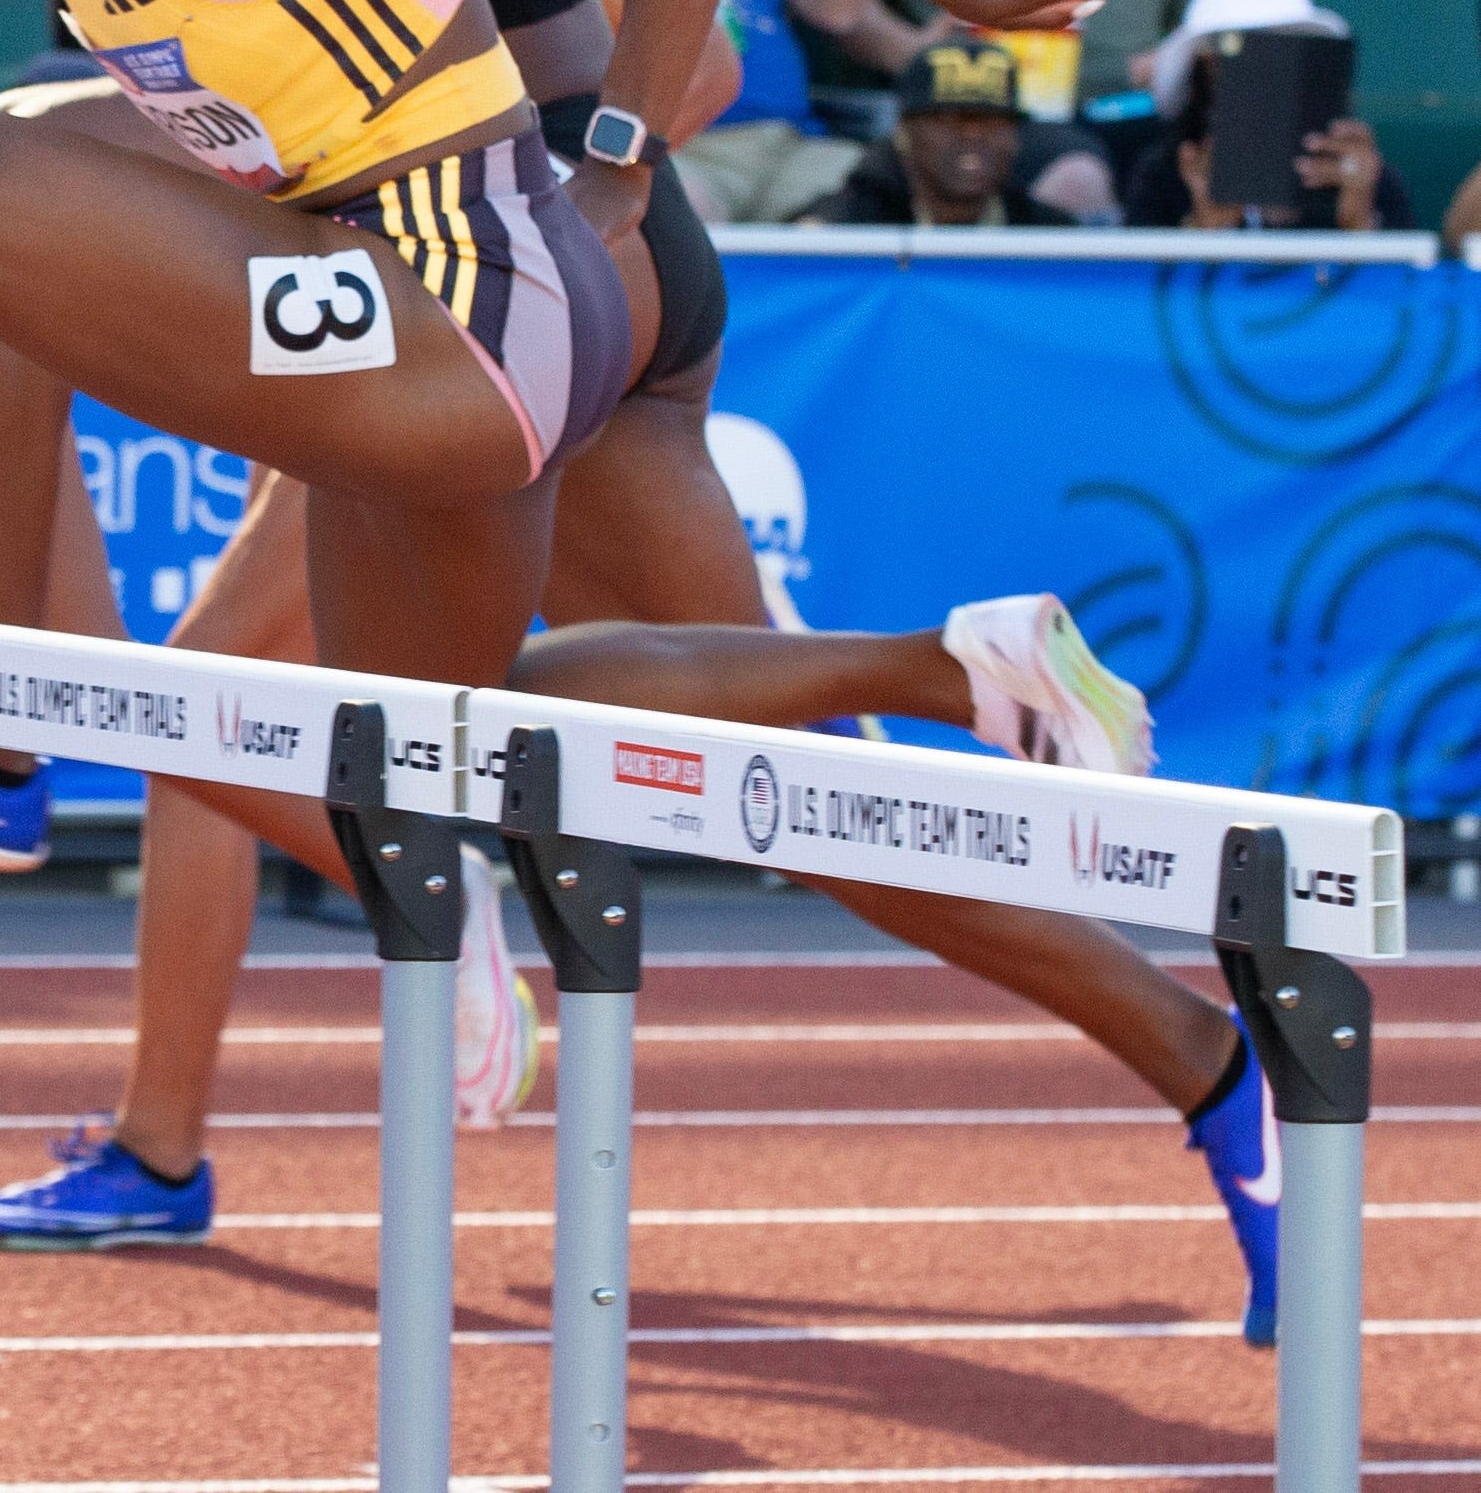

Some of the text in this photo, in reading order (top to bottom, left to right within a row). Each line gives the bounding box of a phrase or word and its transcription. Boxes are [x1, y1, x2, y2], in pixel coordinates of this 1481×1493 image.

[264, 271, 376, 352] 3
[25, 677, 87, 727] OLYMPIC
[90, 685, 131, 733] TEAM
[134, 690, 185, 741] TRIALS
[240, 719, 302, 760] USATF
[389, 738, 442, 772] UCS
[471, 747, 507, 780] UC
[788, 784, 1031, 867] U.S. OLYMPIC TEAM TRIALS
[1101, 842, 1178, 890] USATF
[1292, 865, 1360, 908] UCS
